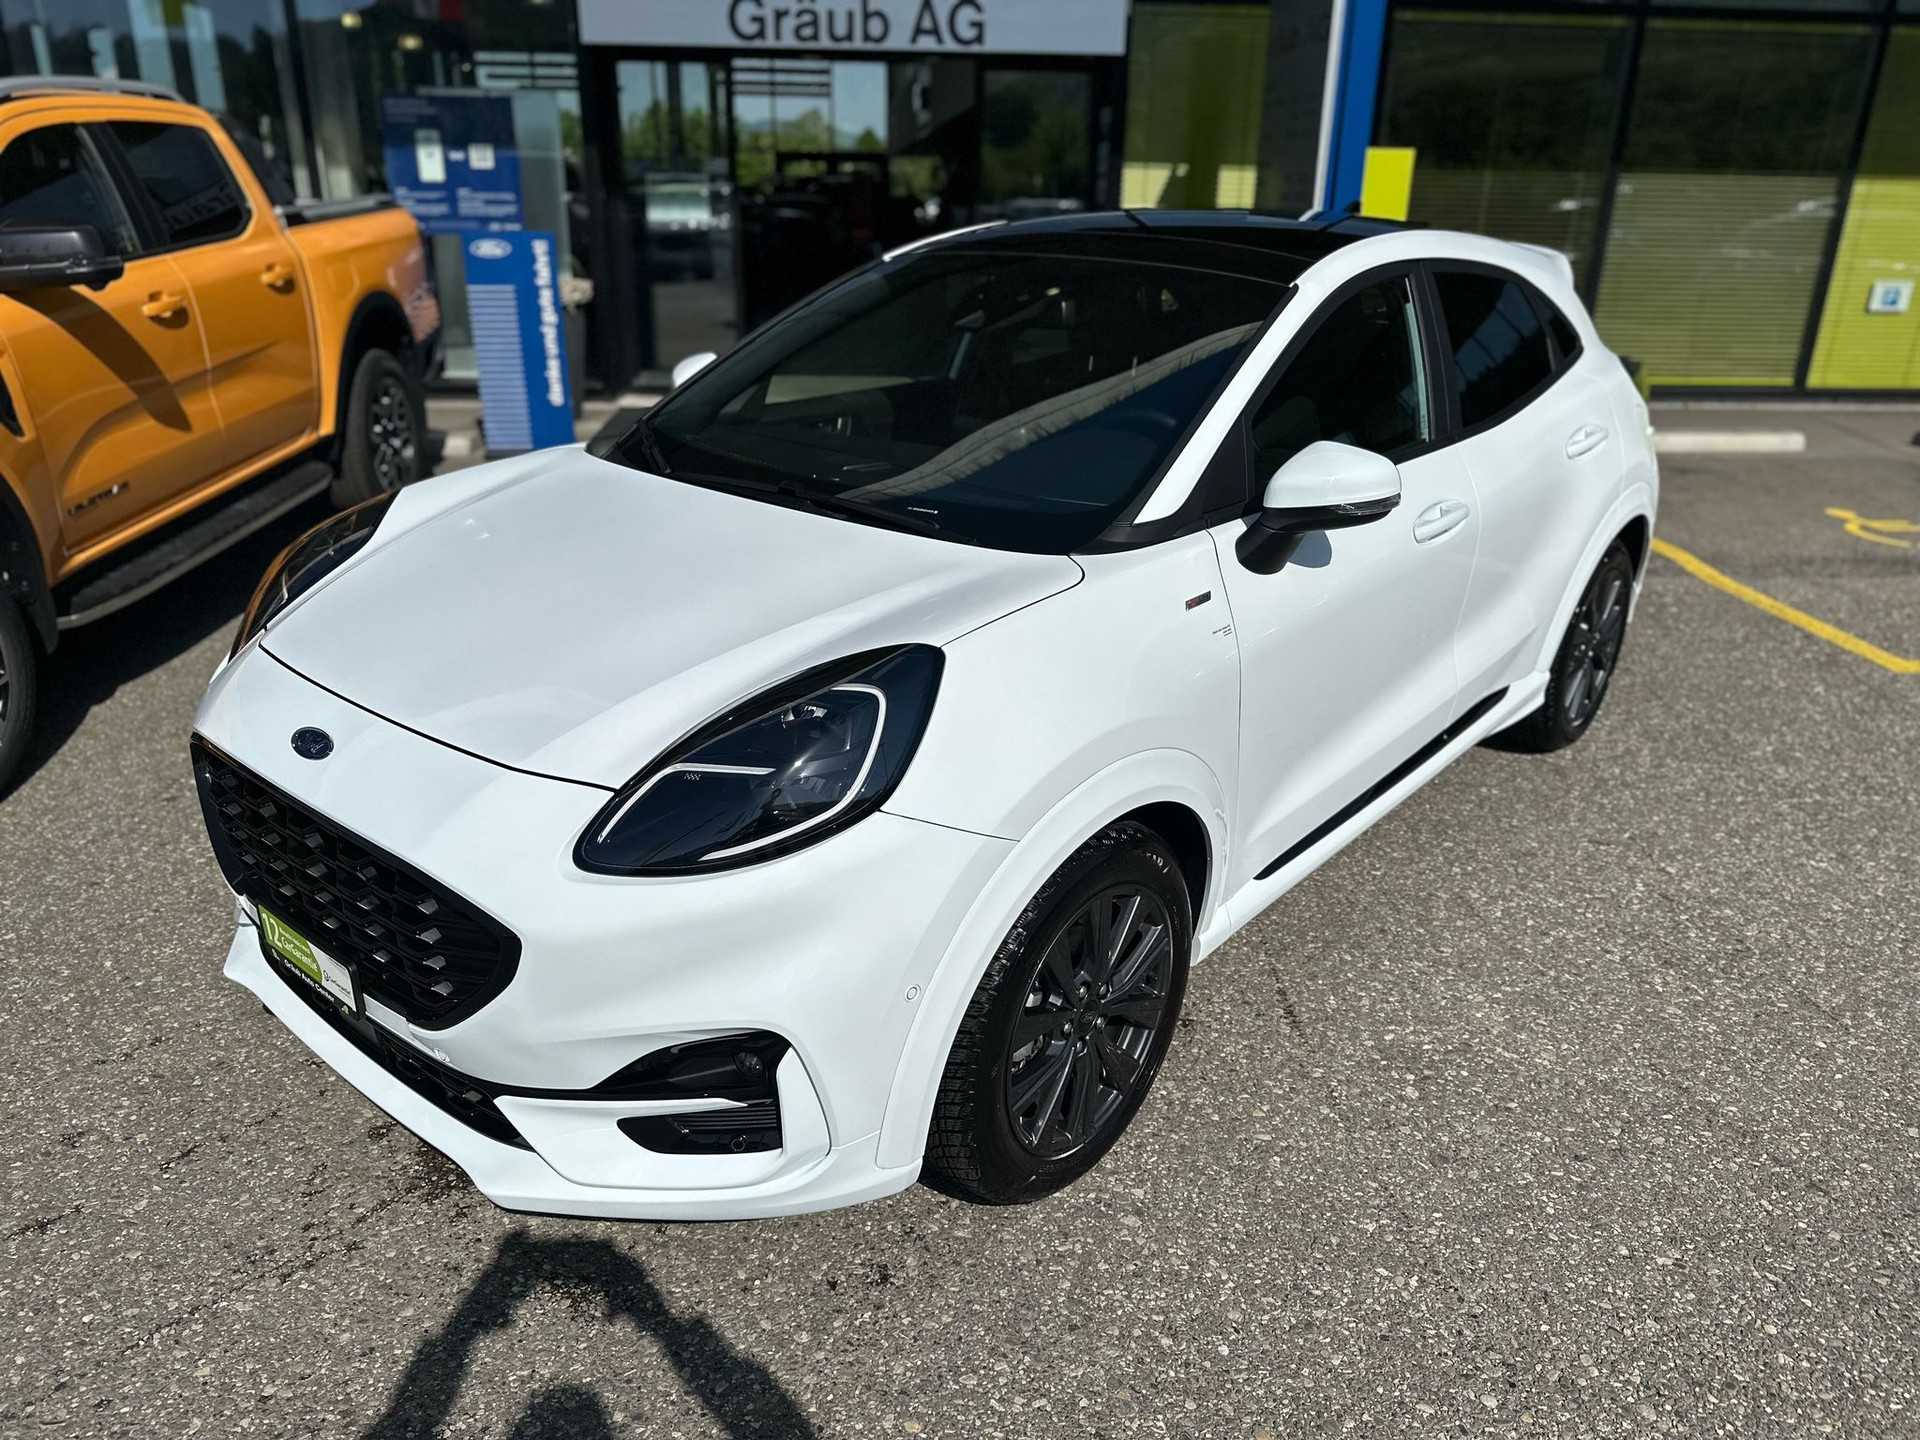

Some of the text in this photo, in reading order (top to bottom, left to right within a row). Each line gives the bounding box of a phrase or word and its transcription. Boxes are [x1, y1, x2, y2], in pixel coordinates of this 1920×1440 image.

[728, 0, 984, 46] Gräub AG
[262, 912, 283, 949] 12
[315, 983, 335, 1003] Center
